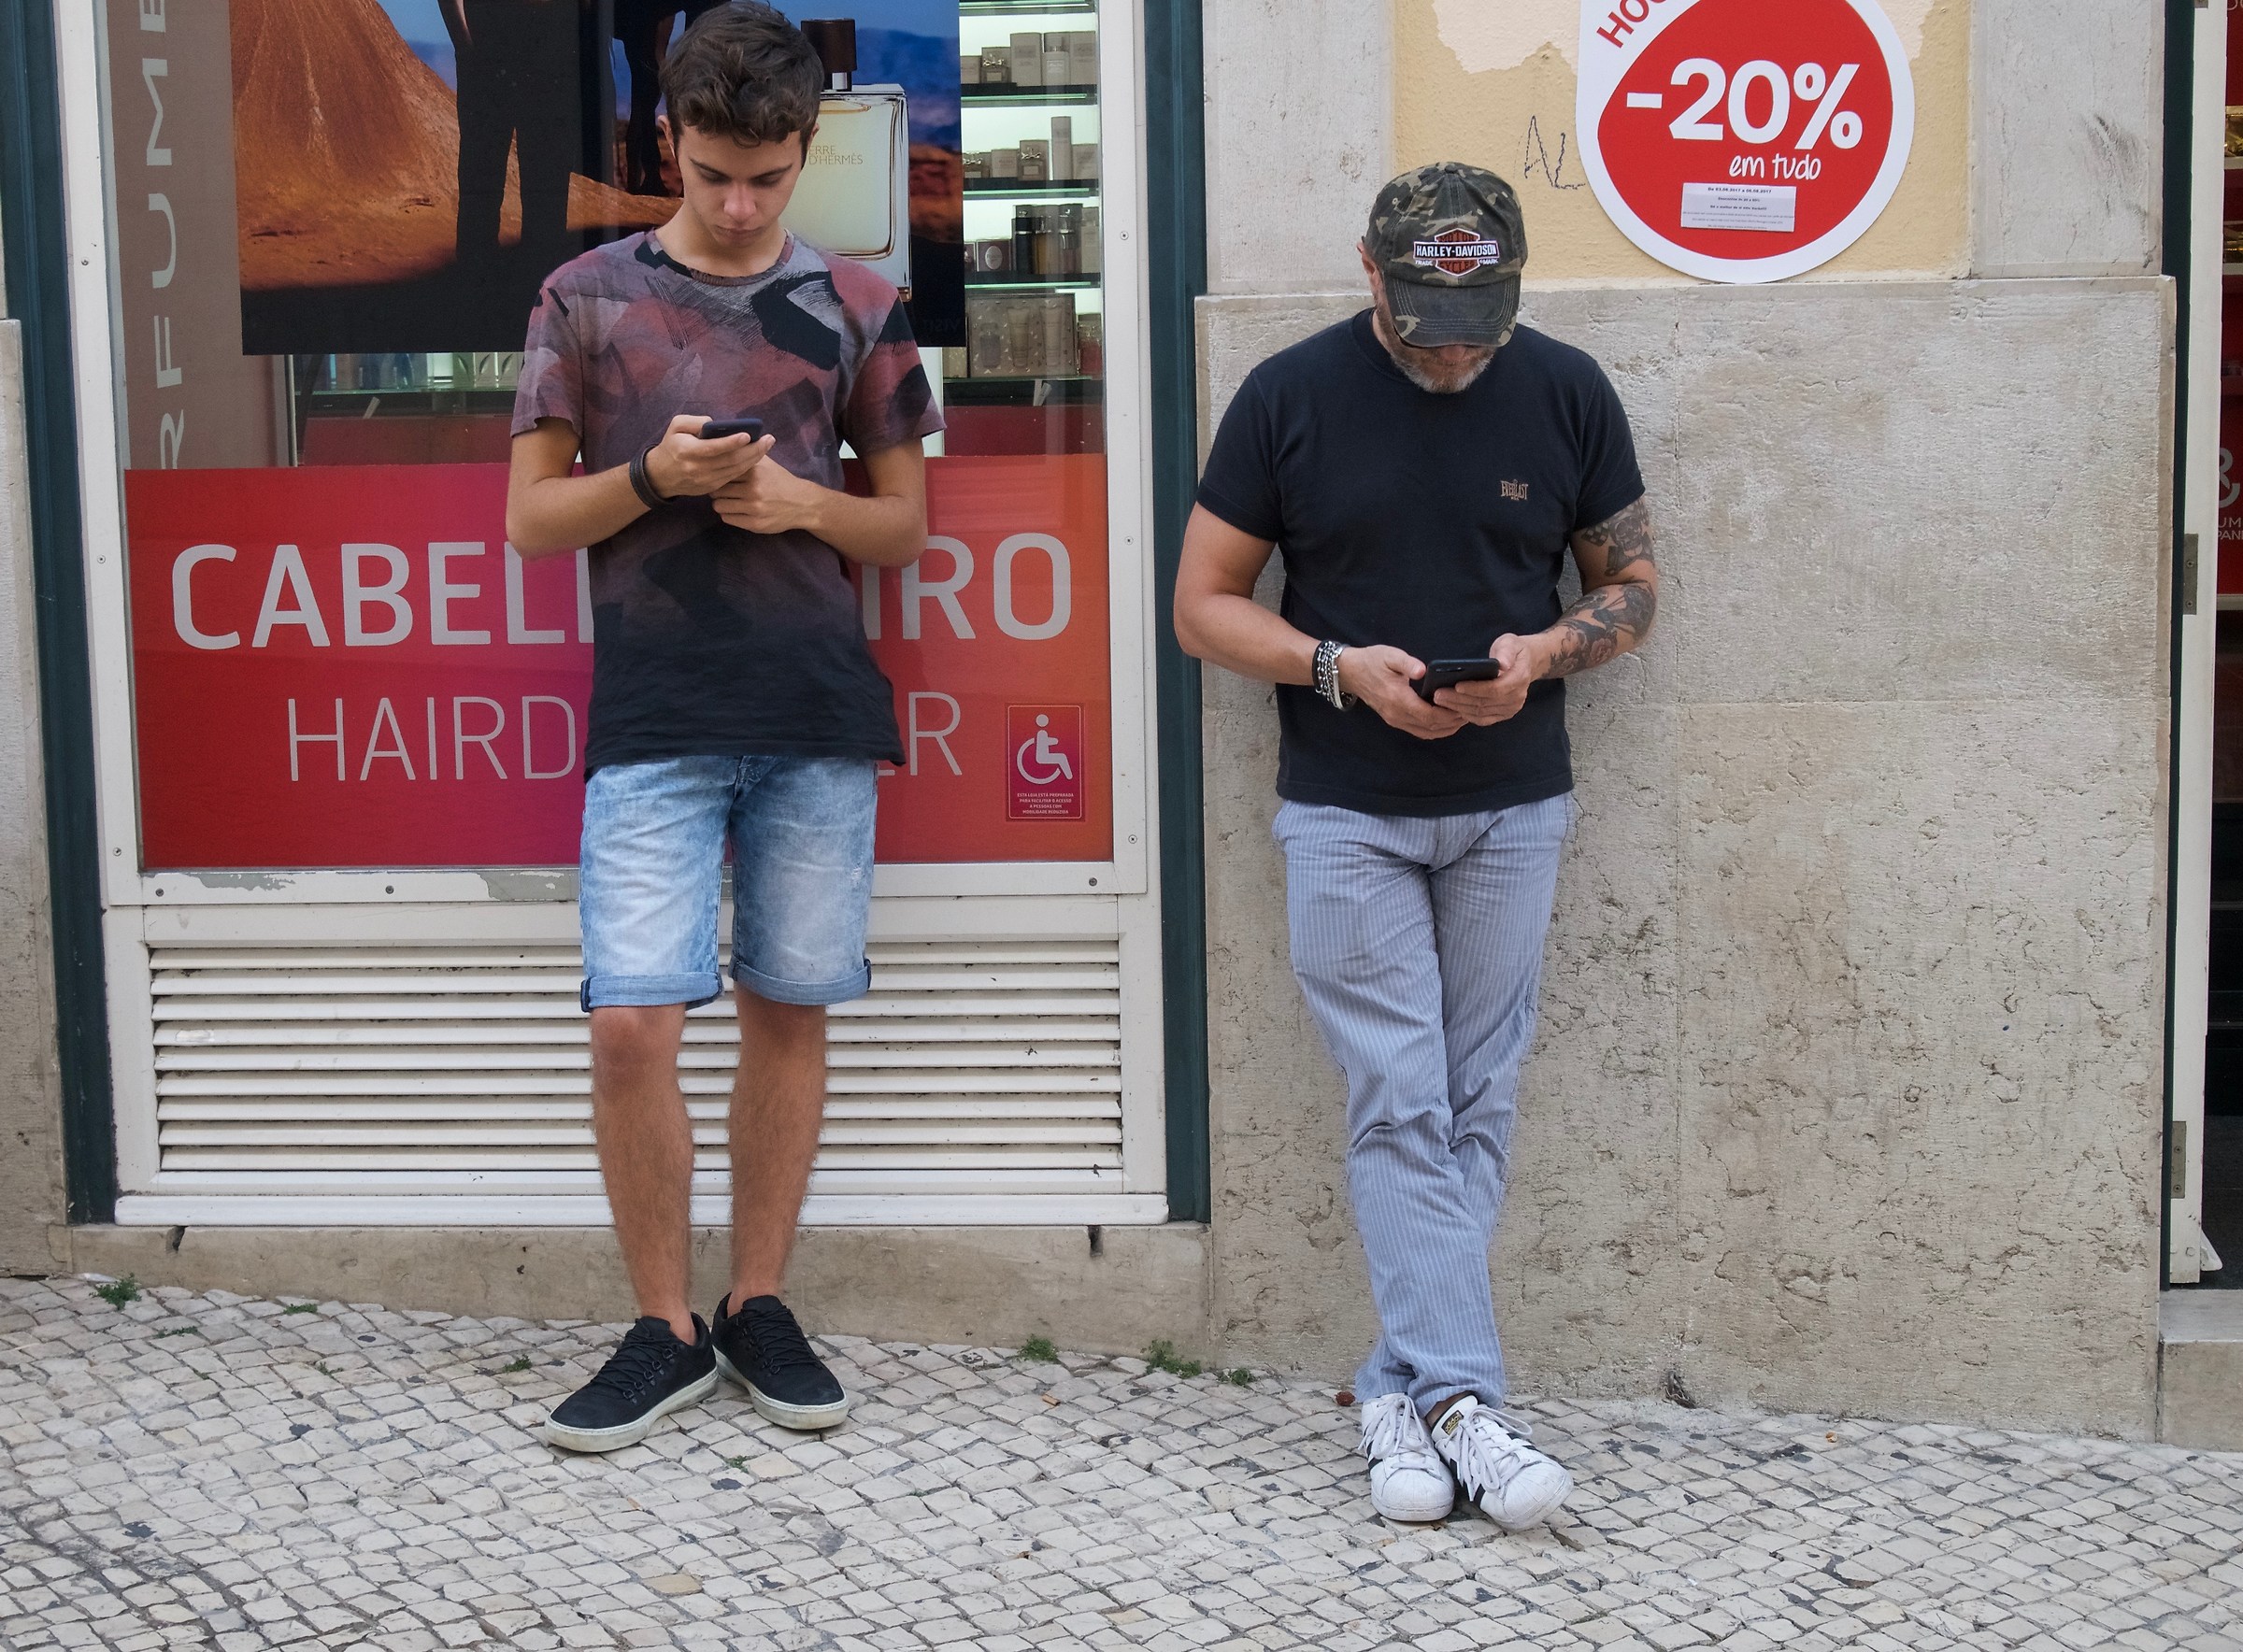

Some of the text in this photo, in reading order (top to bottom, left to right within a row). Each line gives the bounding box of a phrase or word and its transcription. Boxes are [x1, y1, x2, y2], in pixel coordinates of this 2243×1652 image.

[1596, 0, 1666, 49] HO
[1626, 58, 1863, 150] -20%
[1728, 152, 1822, 180] em tudo
[1416, 243, 1497, 257] HARLEY-DAVIDSON
